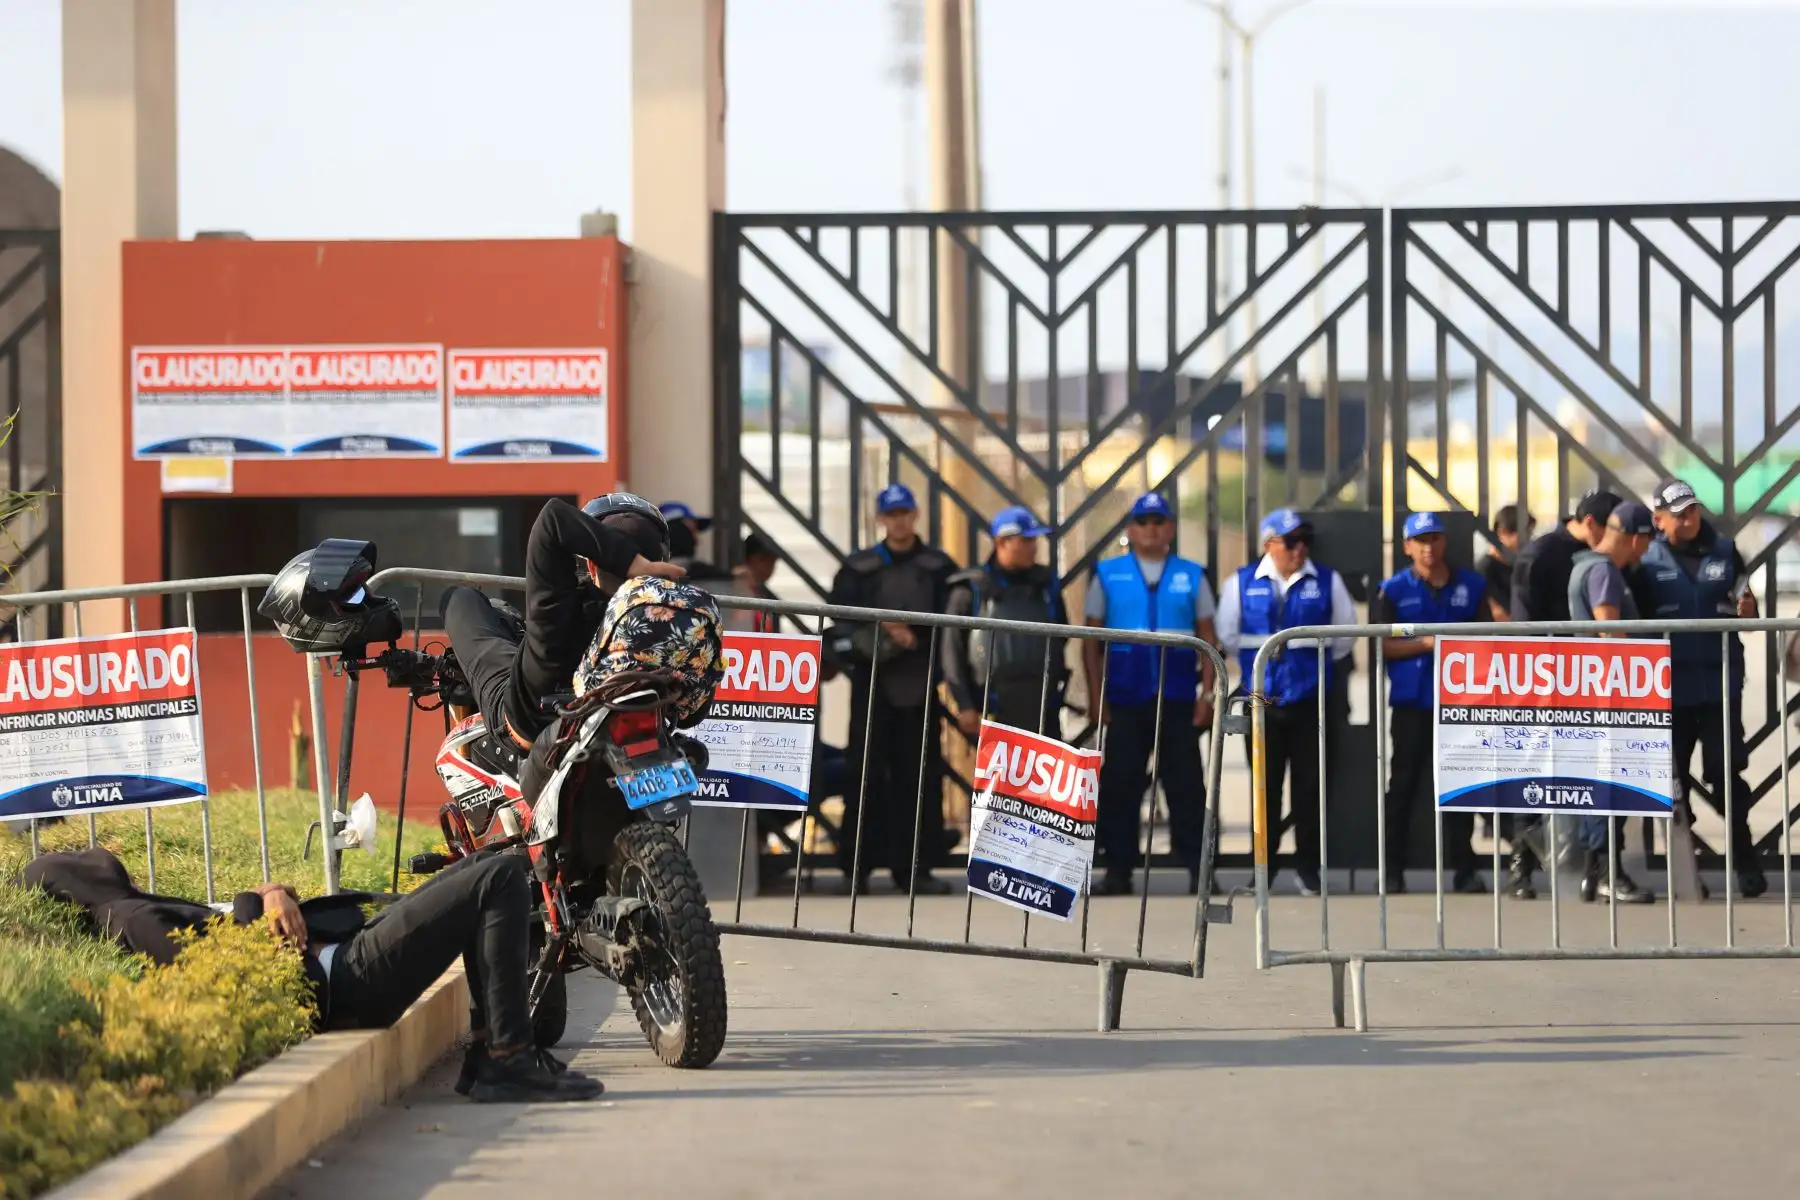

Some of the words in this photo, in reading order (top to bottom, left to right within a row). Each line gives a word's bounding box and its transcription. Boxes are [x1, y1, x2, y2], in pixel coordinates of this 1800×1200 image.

[138, 355, 285, 387] CLAUSURADO
[291, 353, 438, 386] CLAUSURADO
[454, 357, 601, 389] CLAUSURADO
[1442, 652, 1671, 699] CLAUSURADO
[58, 707, 114, 725] NORMAS
[116, 699, 196, 720] MUNICIPALES
[709, 703, 729, 716] AS
[732, 704, 815, 720] MUNICIPALES
[1442, 708, 1467, 722] POR
[1470, 708, 1534, 723] INFRINGIR
[1536, 709, 1591, 724] NORMAS
[74, 787, 123, 805] LIMA
[1546, 790, 1594, 806] LIMA
[1023, 807, 1073, 831] NORMAS
[1007, 882, 1052, 908] LIMA
